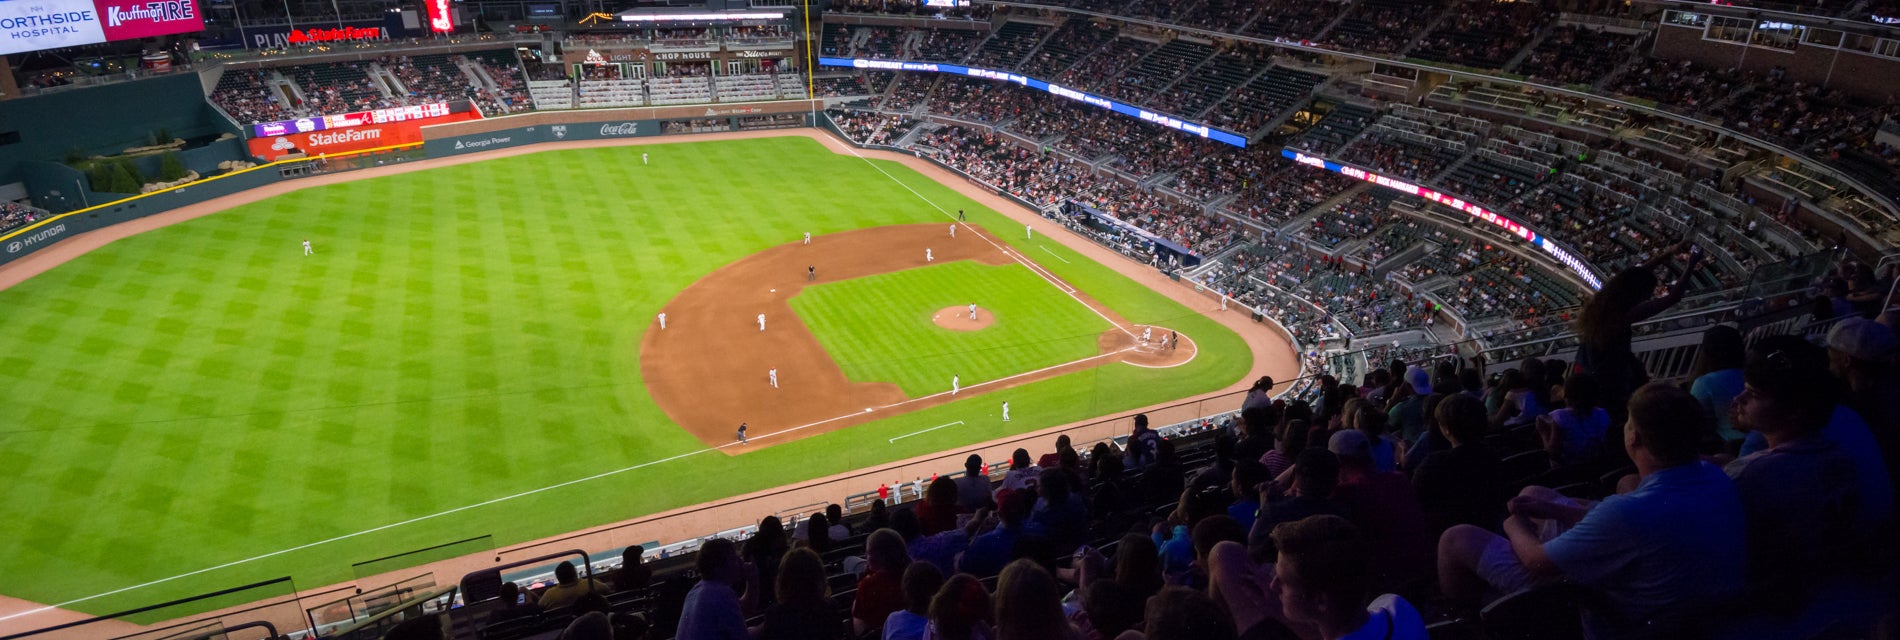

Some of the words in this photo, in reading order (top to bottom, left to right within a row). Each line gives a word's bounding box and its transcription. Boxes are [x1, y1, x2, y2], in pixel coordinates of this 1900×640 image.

[146, 0, 193, 22] TIRE
[0, 11, 94, 29] ORTHSIDE
[11, 27, 79, 39] HOSPITAL
[869, 60, 903, 70] SOUTHEAST
[309, 129, 380, 146] StateFarm
[1368, 173, 1377, 182] 22
[24, 223, 66, 247] HYUNDAI
